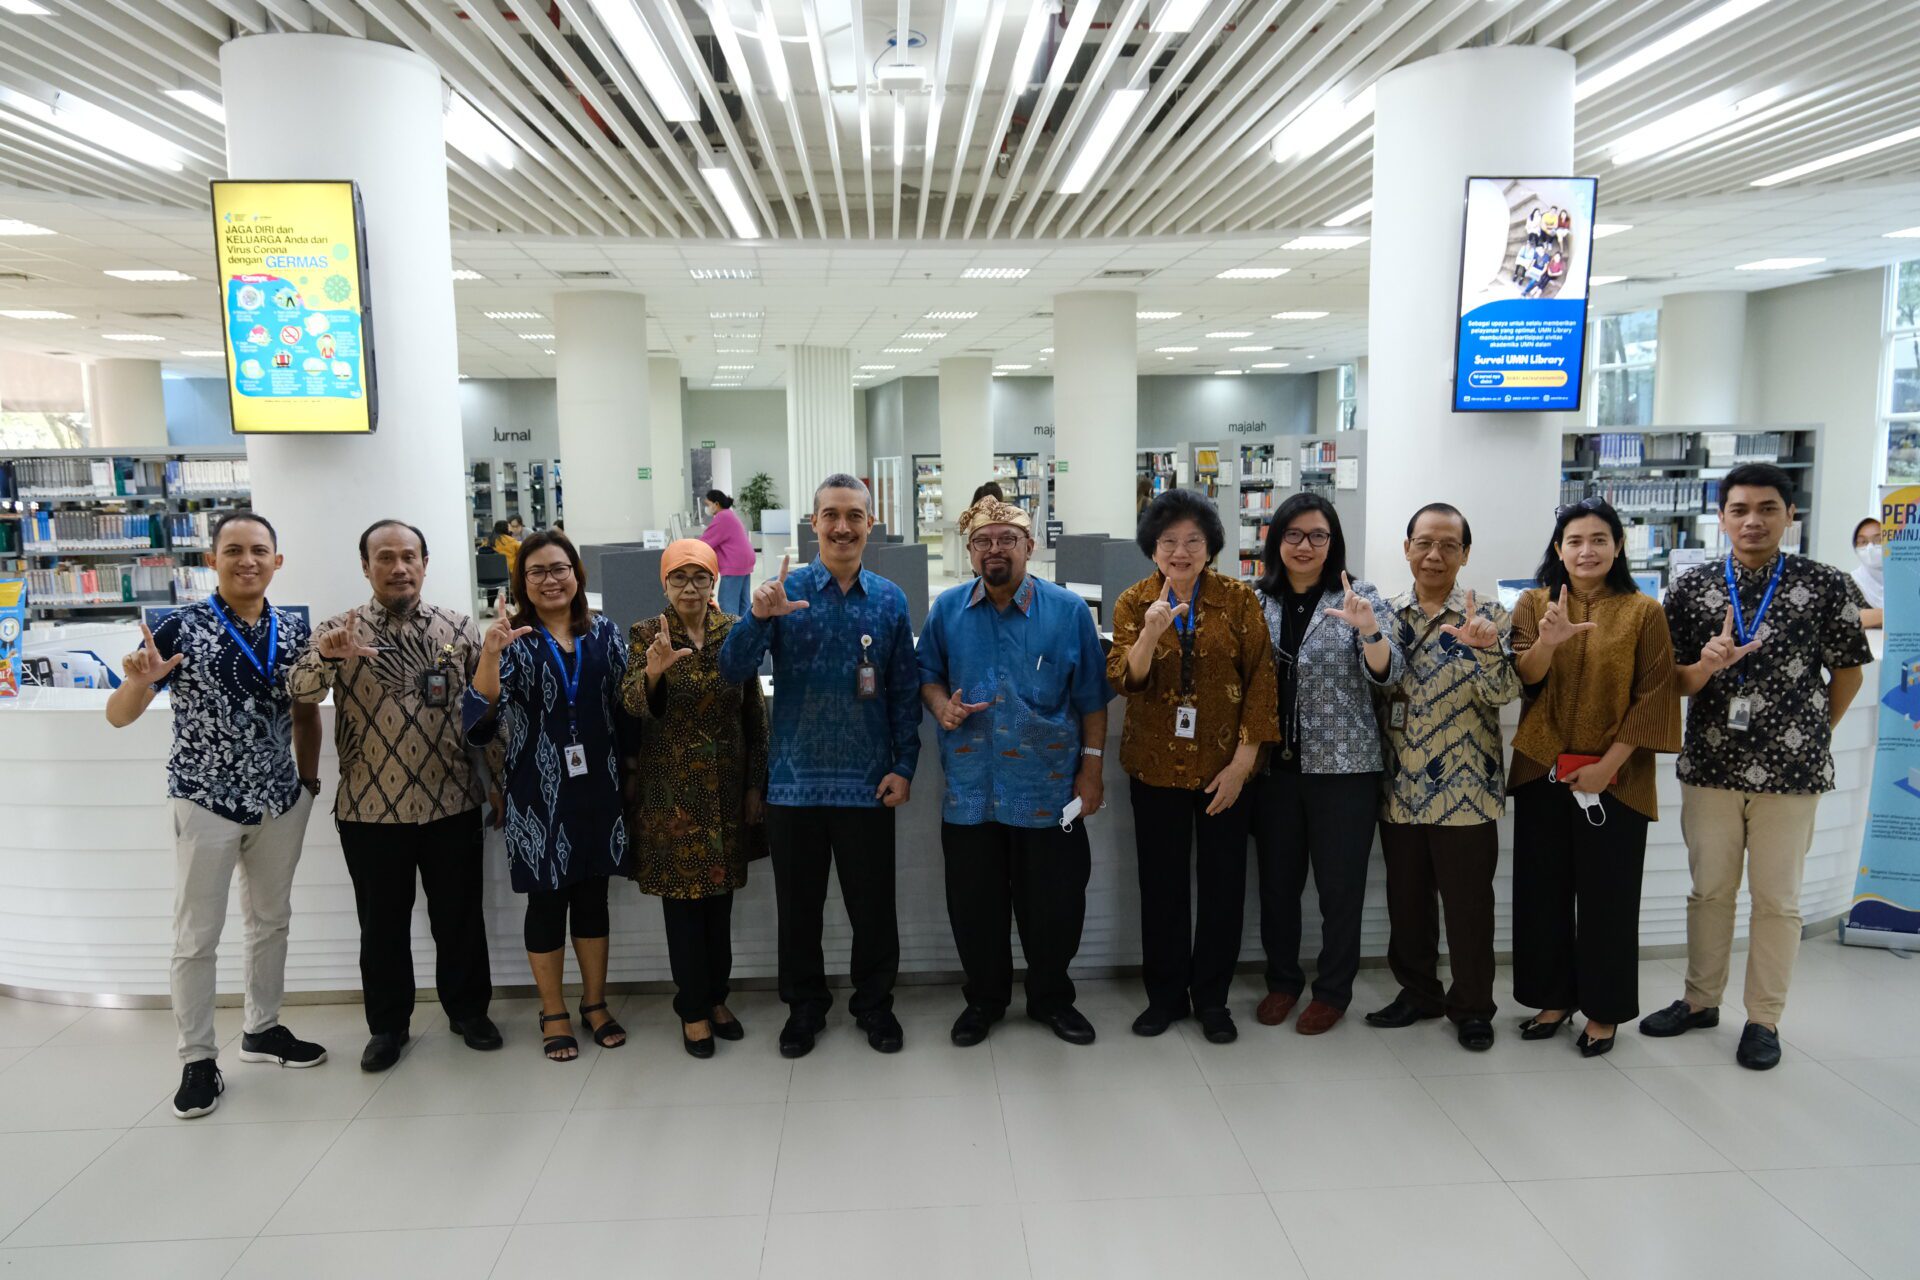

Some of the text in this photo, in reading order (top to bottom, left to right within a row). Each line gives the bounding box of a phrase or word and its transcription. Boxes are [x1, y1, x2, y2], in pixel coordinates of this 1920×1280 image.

[225, 225, 294, 234] JAGA DIRI dan
[226, 235, 282, 244] KELUARGA
[284, 235, 309, 244] Anda
[227, 245, 288, 254] Virus Corona
[228, 255, 329, 269] dengan GERMAS
[1468, 320, 1490, 328] Sebagai
[1553, 327, 1573, 335] Library
[1474, 354, 1565, 367] Survei UMN Library
[1228, 420, 1267, 435] majalah
[1882, 503, 1920, 525] PER
[1882, 529, 1920, 542] PEMINJ
